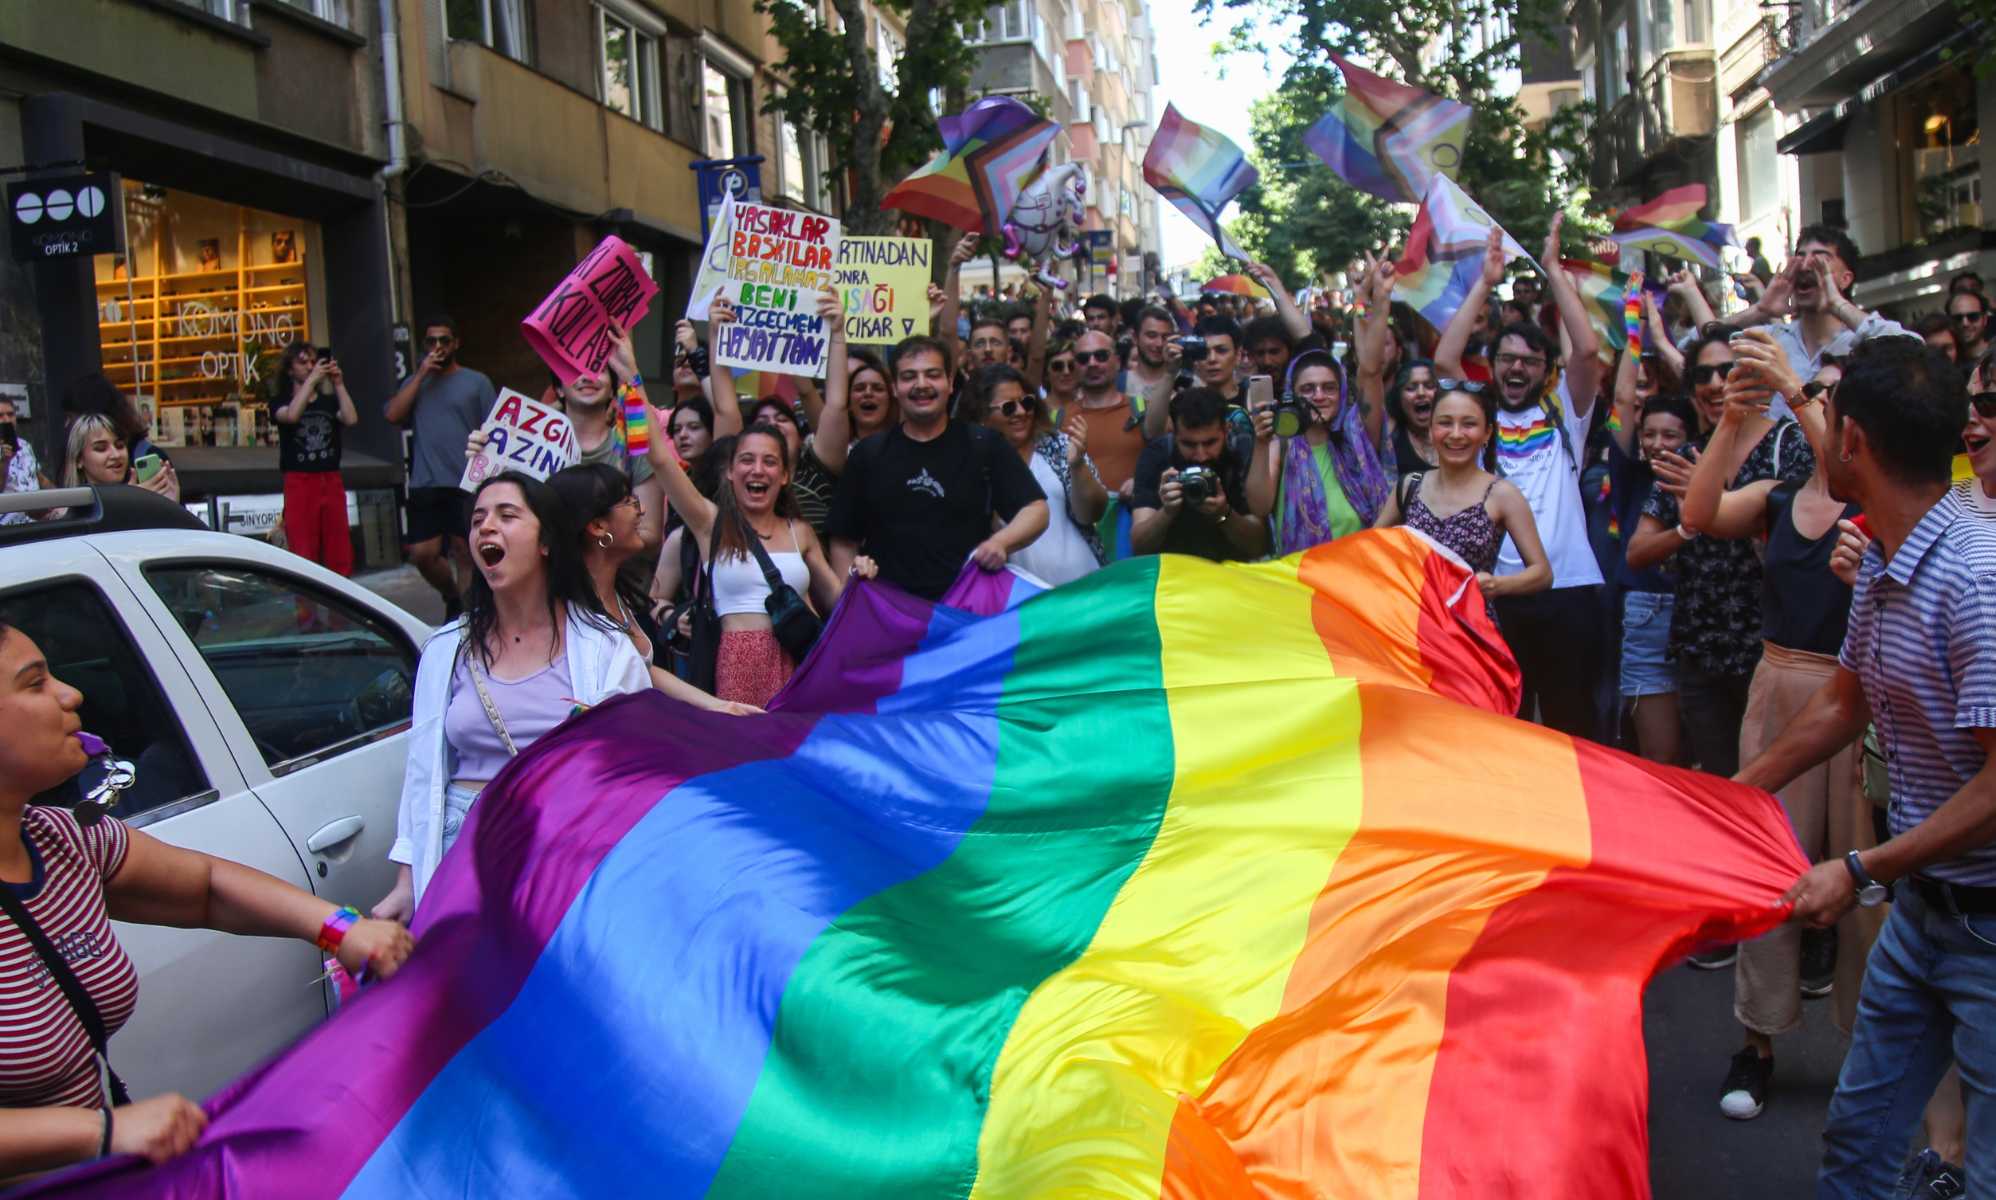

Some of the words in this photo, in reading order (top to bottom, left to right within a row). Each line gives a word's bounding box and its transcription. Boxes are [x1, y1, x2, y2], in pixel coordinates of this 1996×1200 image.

[735, 204, 830, 245] YASAKLAR
[733, 230, 832, 271] BASKILAR
[740, 282, 798, 312] BENİ
[845, 316, 894, 339] ÇIKAR
